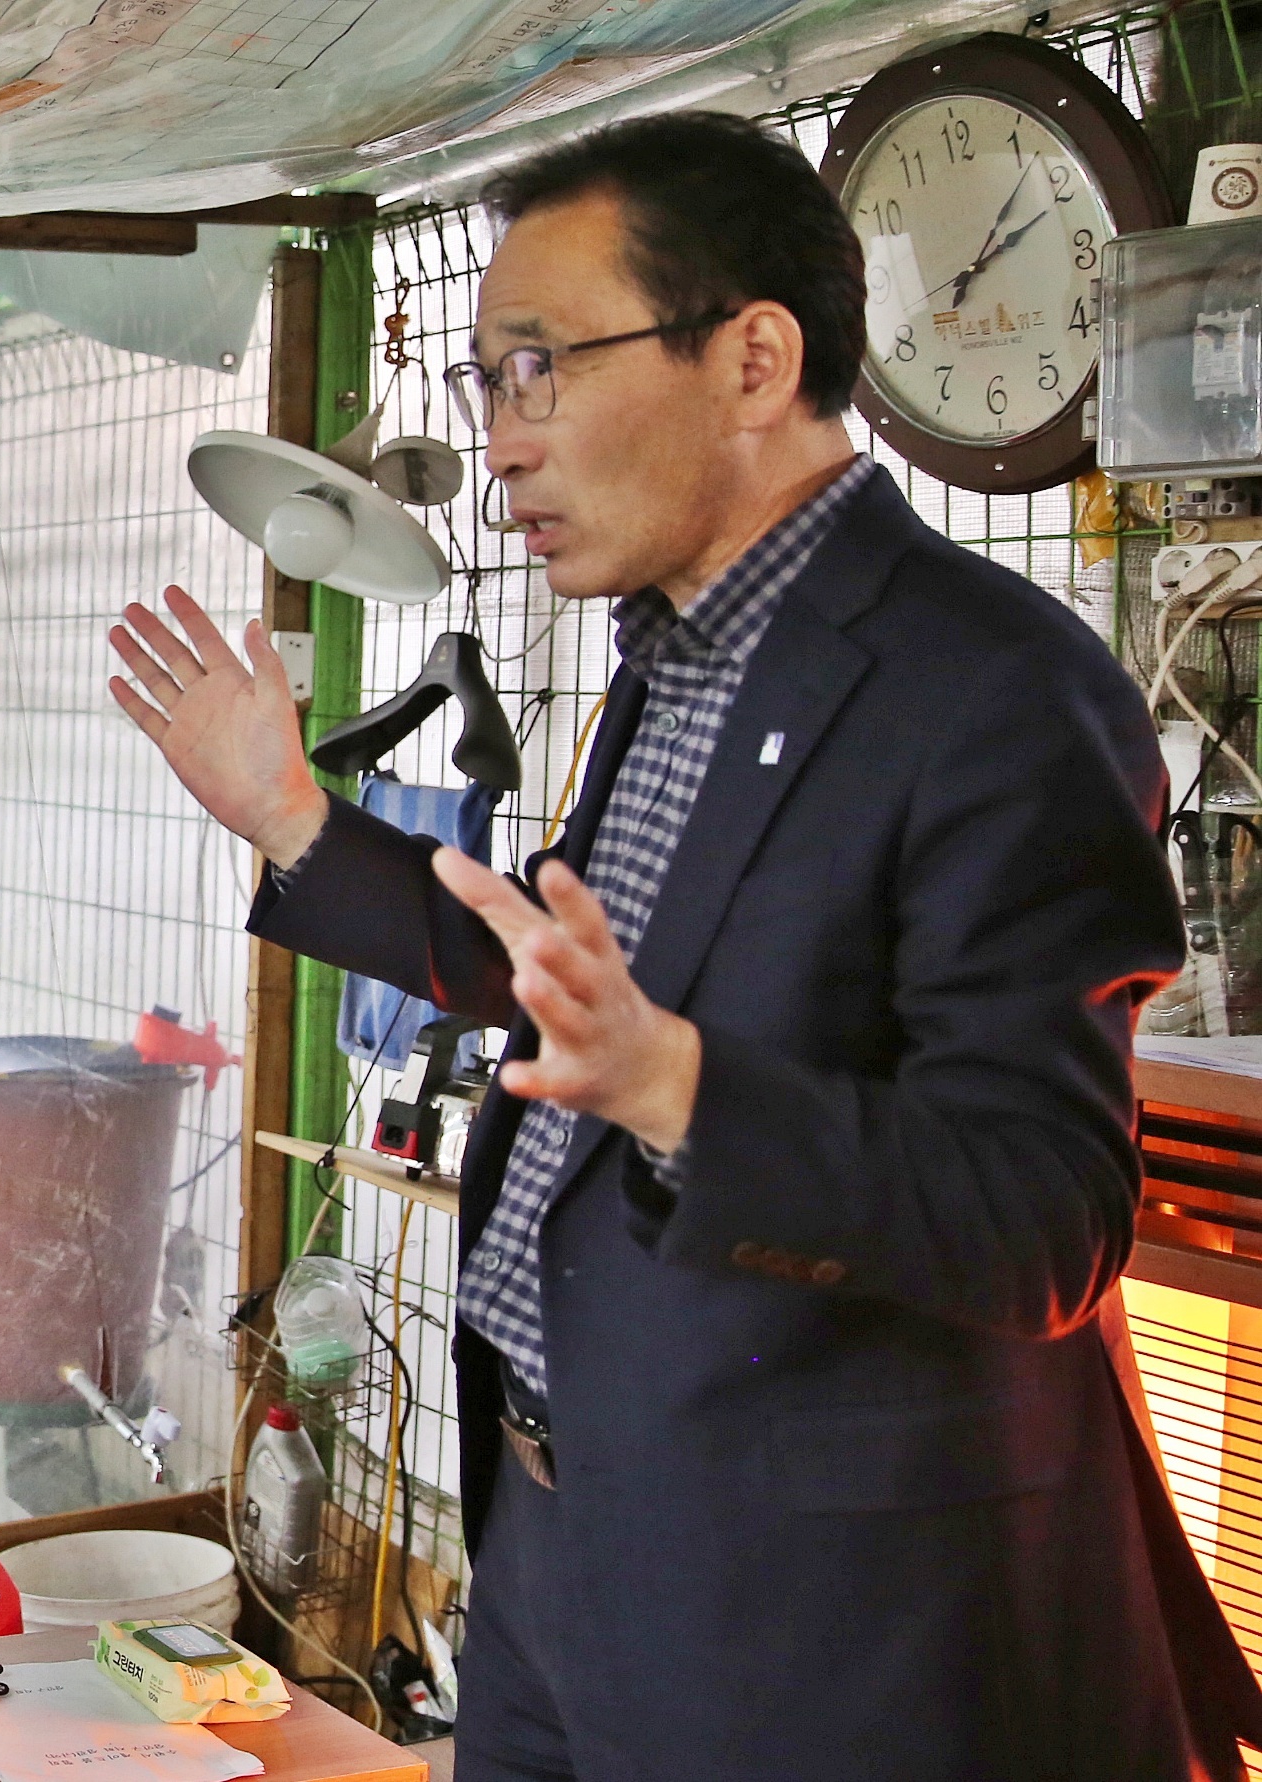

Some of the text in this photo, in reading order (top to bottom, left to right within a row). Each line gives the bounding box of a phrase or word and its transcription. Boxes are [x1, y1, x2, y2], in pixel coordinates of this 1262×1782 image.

[941, 119, 976, 163] 12
[1008, 130, 1023, 168] 1
[899, 150, 927, 189] 11
[1049, 164, 1076, 203] 2
[872, 199, 902, 236] 10
[1074, 229, 1097, 270] 3
[1068, 296, 1092, 338] 4
[895, 325, 916, 361] 8
[934, 365, 954, 400] 7
[1038, 350, 1059, 390] 5
[986, 375, 1008, 415] 6
[113, 1650, 144, 1683] 그린터치
